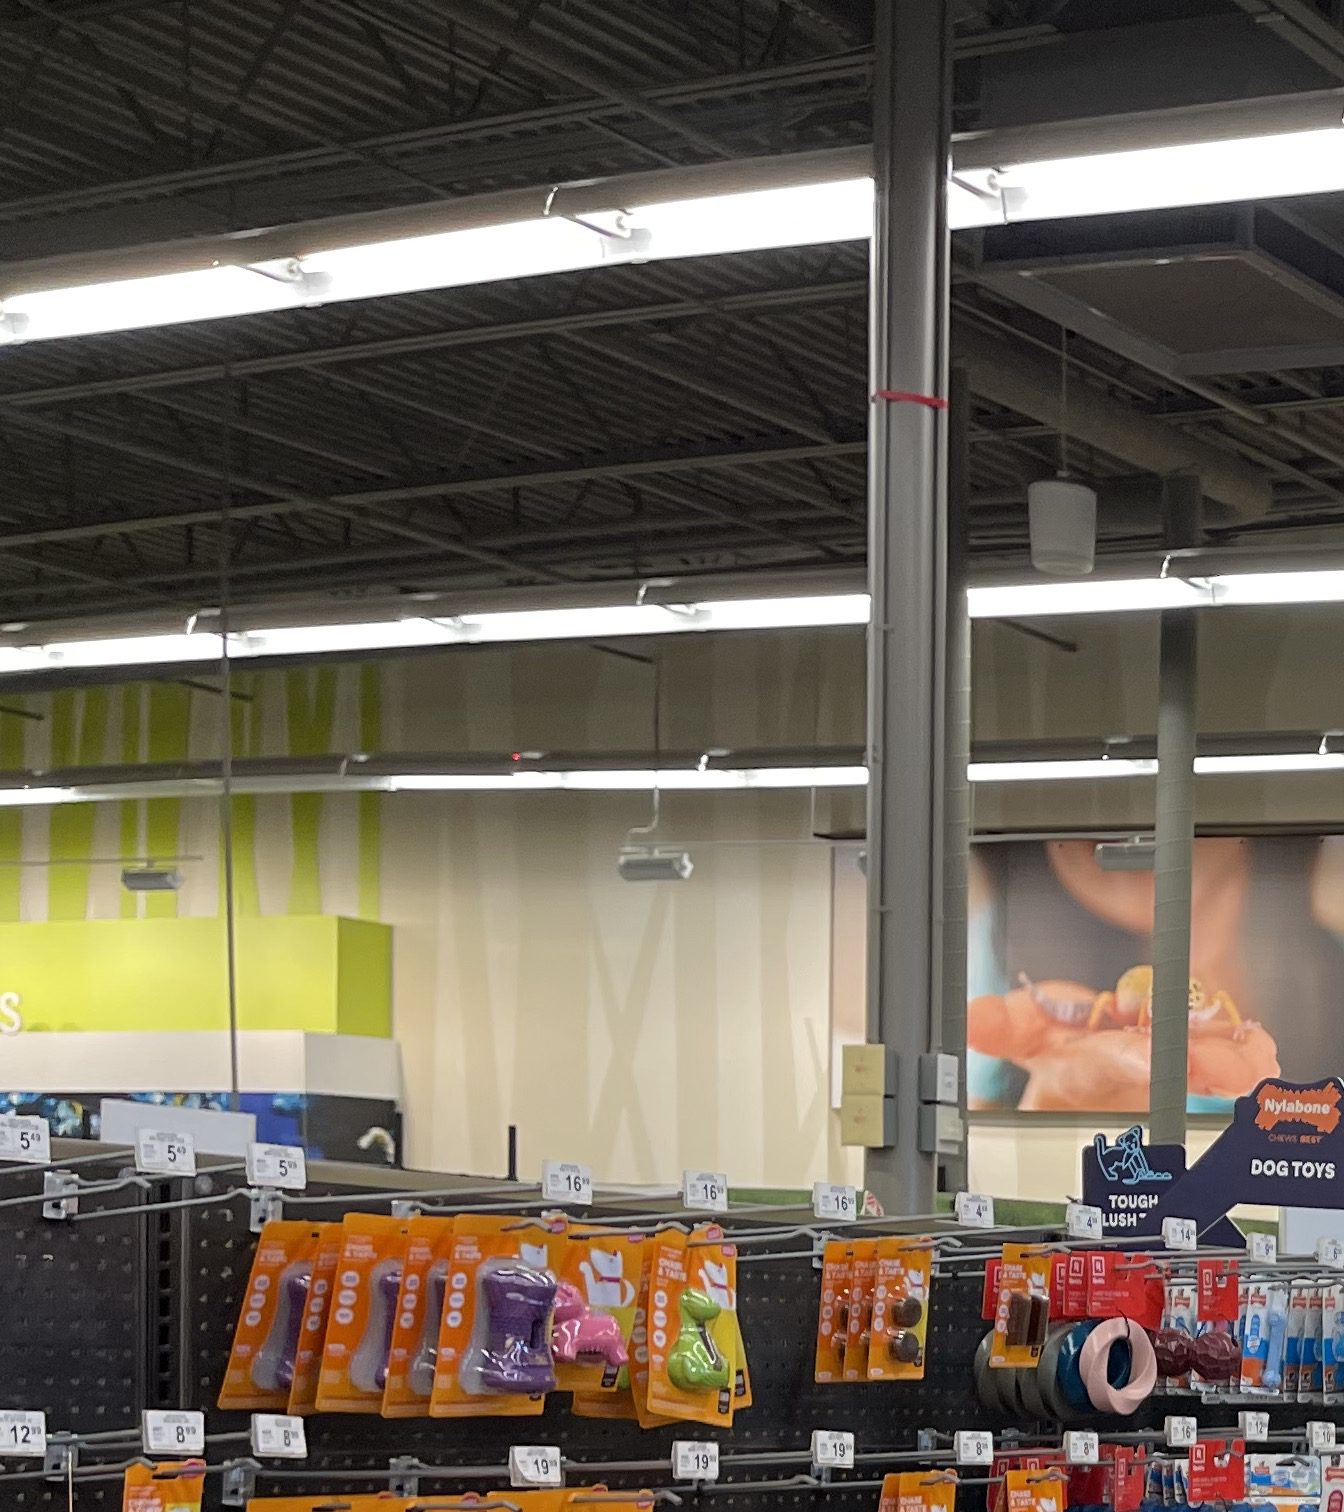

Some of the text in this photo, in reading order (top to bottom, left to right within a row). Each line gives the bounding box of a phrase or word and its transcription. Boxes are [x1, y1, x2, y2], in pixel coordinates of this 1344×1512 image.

[1264, 1098, 1330, 1115] Nylabone
[1251, 1159, 1336, 1180] DOG TOYS
[1108, 1194, 1158, 1209] TOUGH
[1102, 1212, 1137, 1227] LUSH
